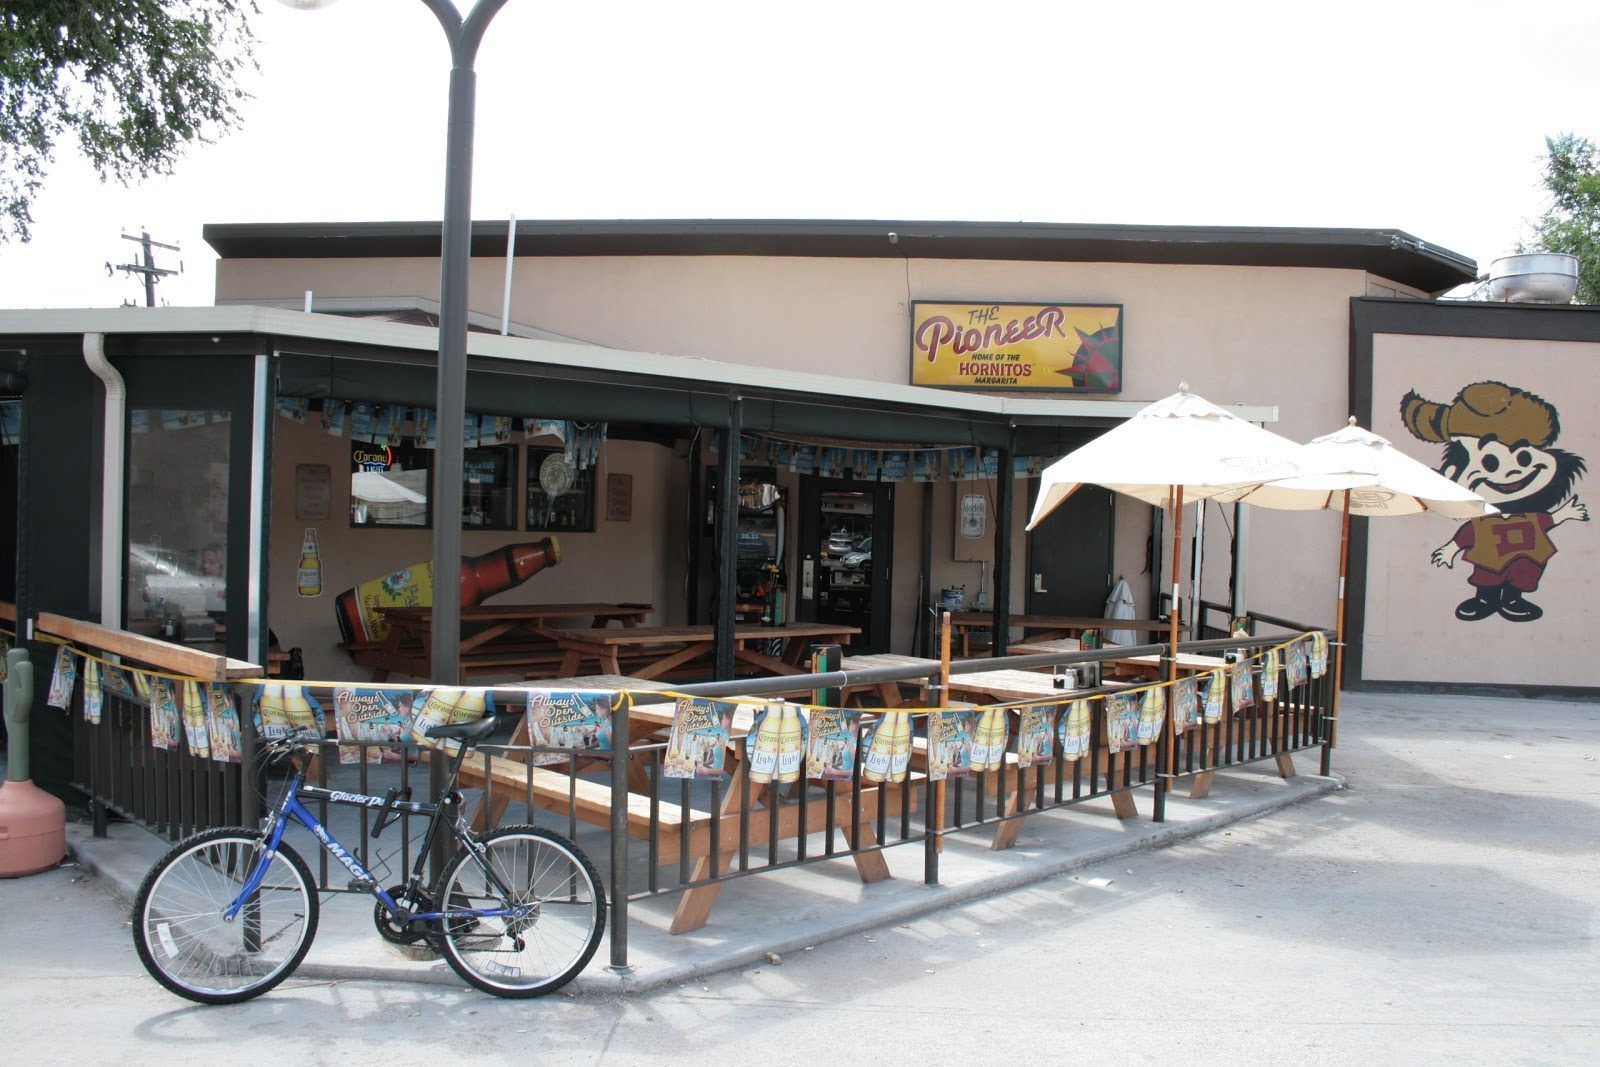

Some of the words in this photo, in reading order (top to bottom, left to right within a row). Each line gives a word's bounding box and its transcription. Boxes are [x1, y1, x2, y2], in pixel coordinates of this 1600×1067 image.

[968, 305, 1000, 325] THE
[971, 353, 993, 361] HOME
[995, 353, 1006, 361] OF
[959, 362, 1033, 377] HORNITOS
[974, 377, 1018, 385] MARGARITA
[337, 691, 381, 704] Always
[531, 694, 577, 708] Always
[351, 702, 380, 713] Open
[545, 706, 575, 718] Open
[677, 699, 711, 714] Always
[347, 709, 389, 723] Outside
[539, 713, 585, 728] Outside
[685, 711, 708, 723] Open
[679, 721, 713, 734] Outside
[756, 753, 775, 765] Light
[330, 790, 369, 804] Glacier
